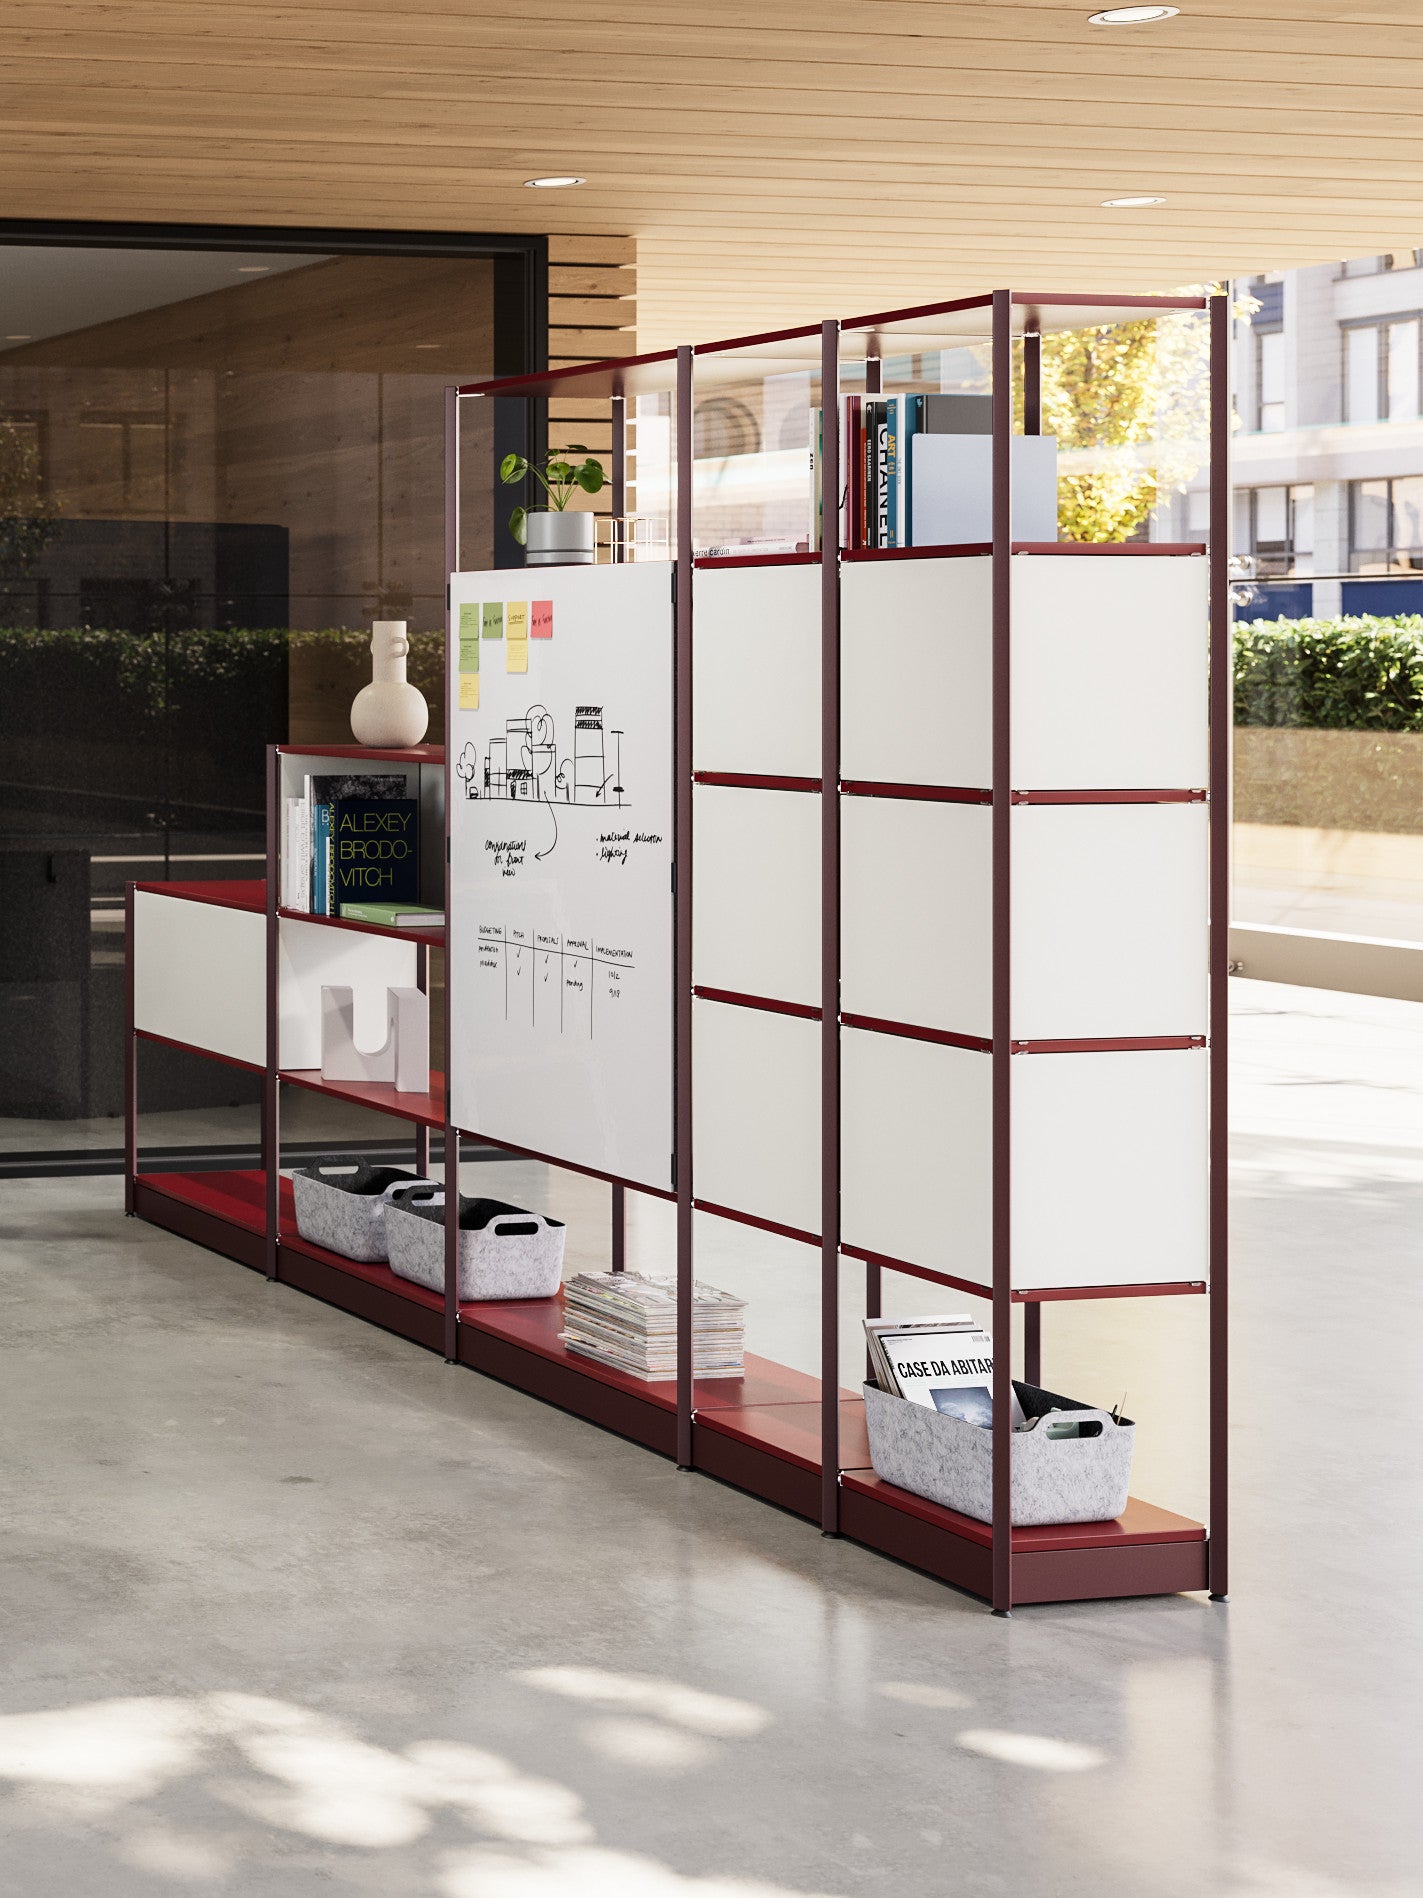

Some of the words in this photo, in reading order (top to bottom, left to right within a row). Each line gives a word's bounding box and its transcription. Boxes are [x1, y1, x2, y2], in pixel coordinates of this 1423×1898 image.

[887, 434, 896, 458] ART
[879, 428, 888, 547] CHANEL
[339, 813, 412, 832] ALEXEY
[340, 840, 412, 860] BRODO-
[339, 867, 393, 887] VITCH
[898, 1361, 932, 1379] CASE
[930, 1360, 951, 1377] DA
[951, 1358, 993, 1376] ABITAR
